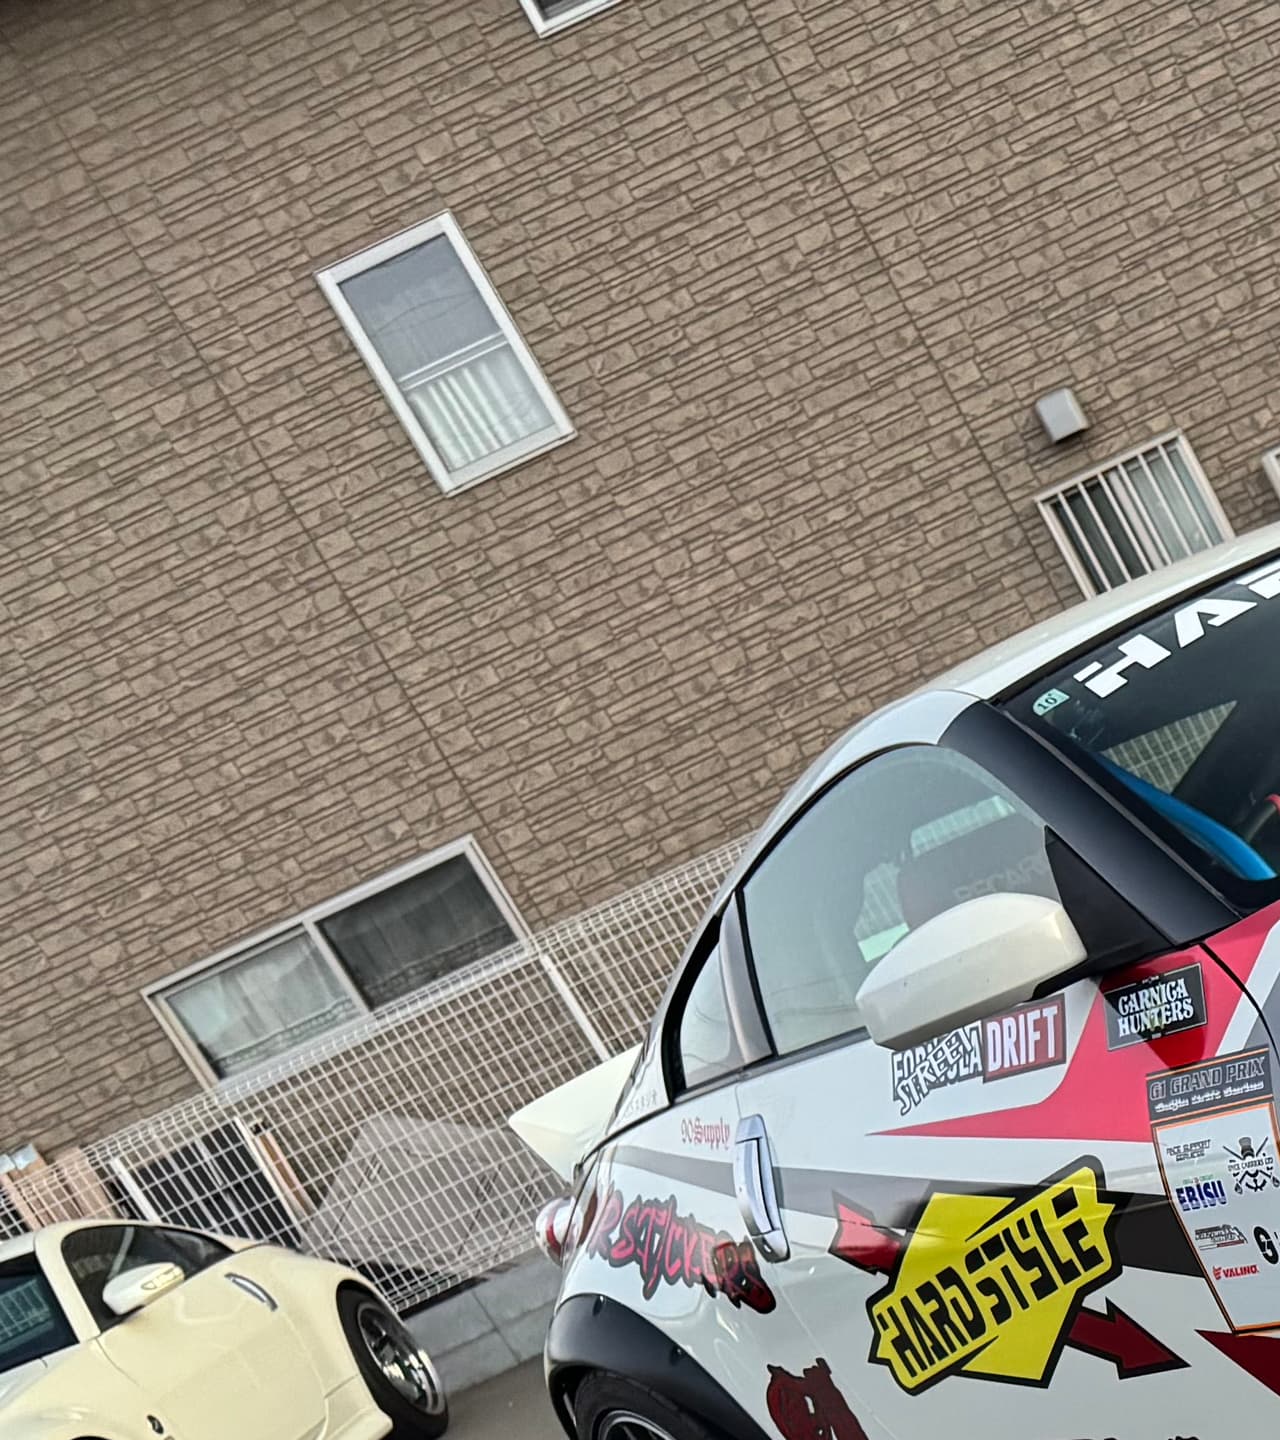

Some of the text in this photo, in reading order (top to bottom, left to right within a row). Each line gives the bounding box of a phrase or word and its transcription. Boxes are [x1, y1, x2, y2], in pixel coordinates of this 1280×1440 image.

[1118, 978, 1189, 1016] GARNICA
[1118, 998, 1195, 1038] HUNTERS
[987, 1004, 1059, 1072] DRIFT
[896, 1022, 981, 1115] STREET
[1171, 1066, 1222, 1095] GRAND
[1226, 1057, 1265, 1083] PRIX
[1175, 1180, 1227, 1211] EBISU
